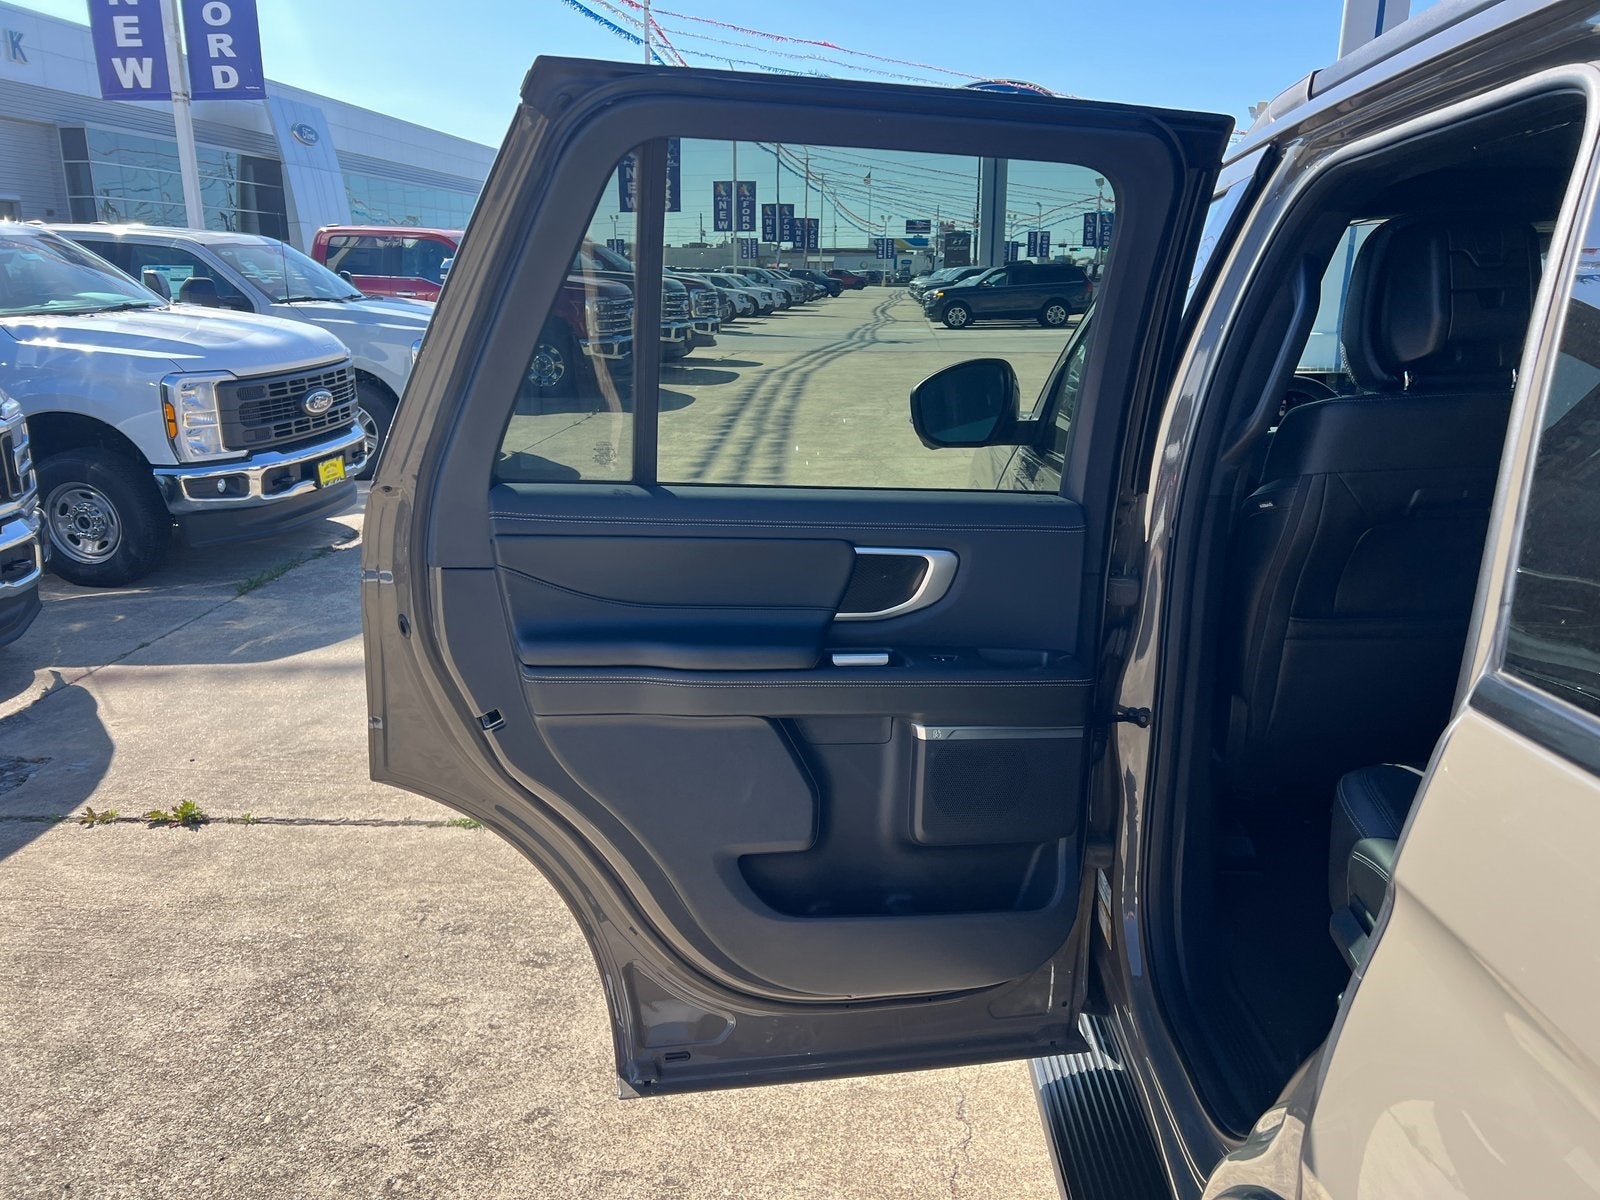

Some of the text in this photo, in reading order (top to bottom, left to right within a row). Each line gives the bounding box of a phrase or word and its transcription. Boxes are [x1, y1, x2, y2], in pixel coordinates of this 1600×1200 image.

[108, 0, 153, 89] EW
[201, 1, 239, 90] ORD
[717, 201, 729, 230] NEW
[742, 201, 751, 230] FORD
[765, 219, 774, 241] NEW
[1085, 226, 1094, 245] NEW
[313, 395, 330, 408] Ford
